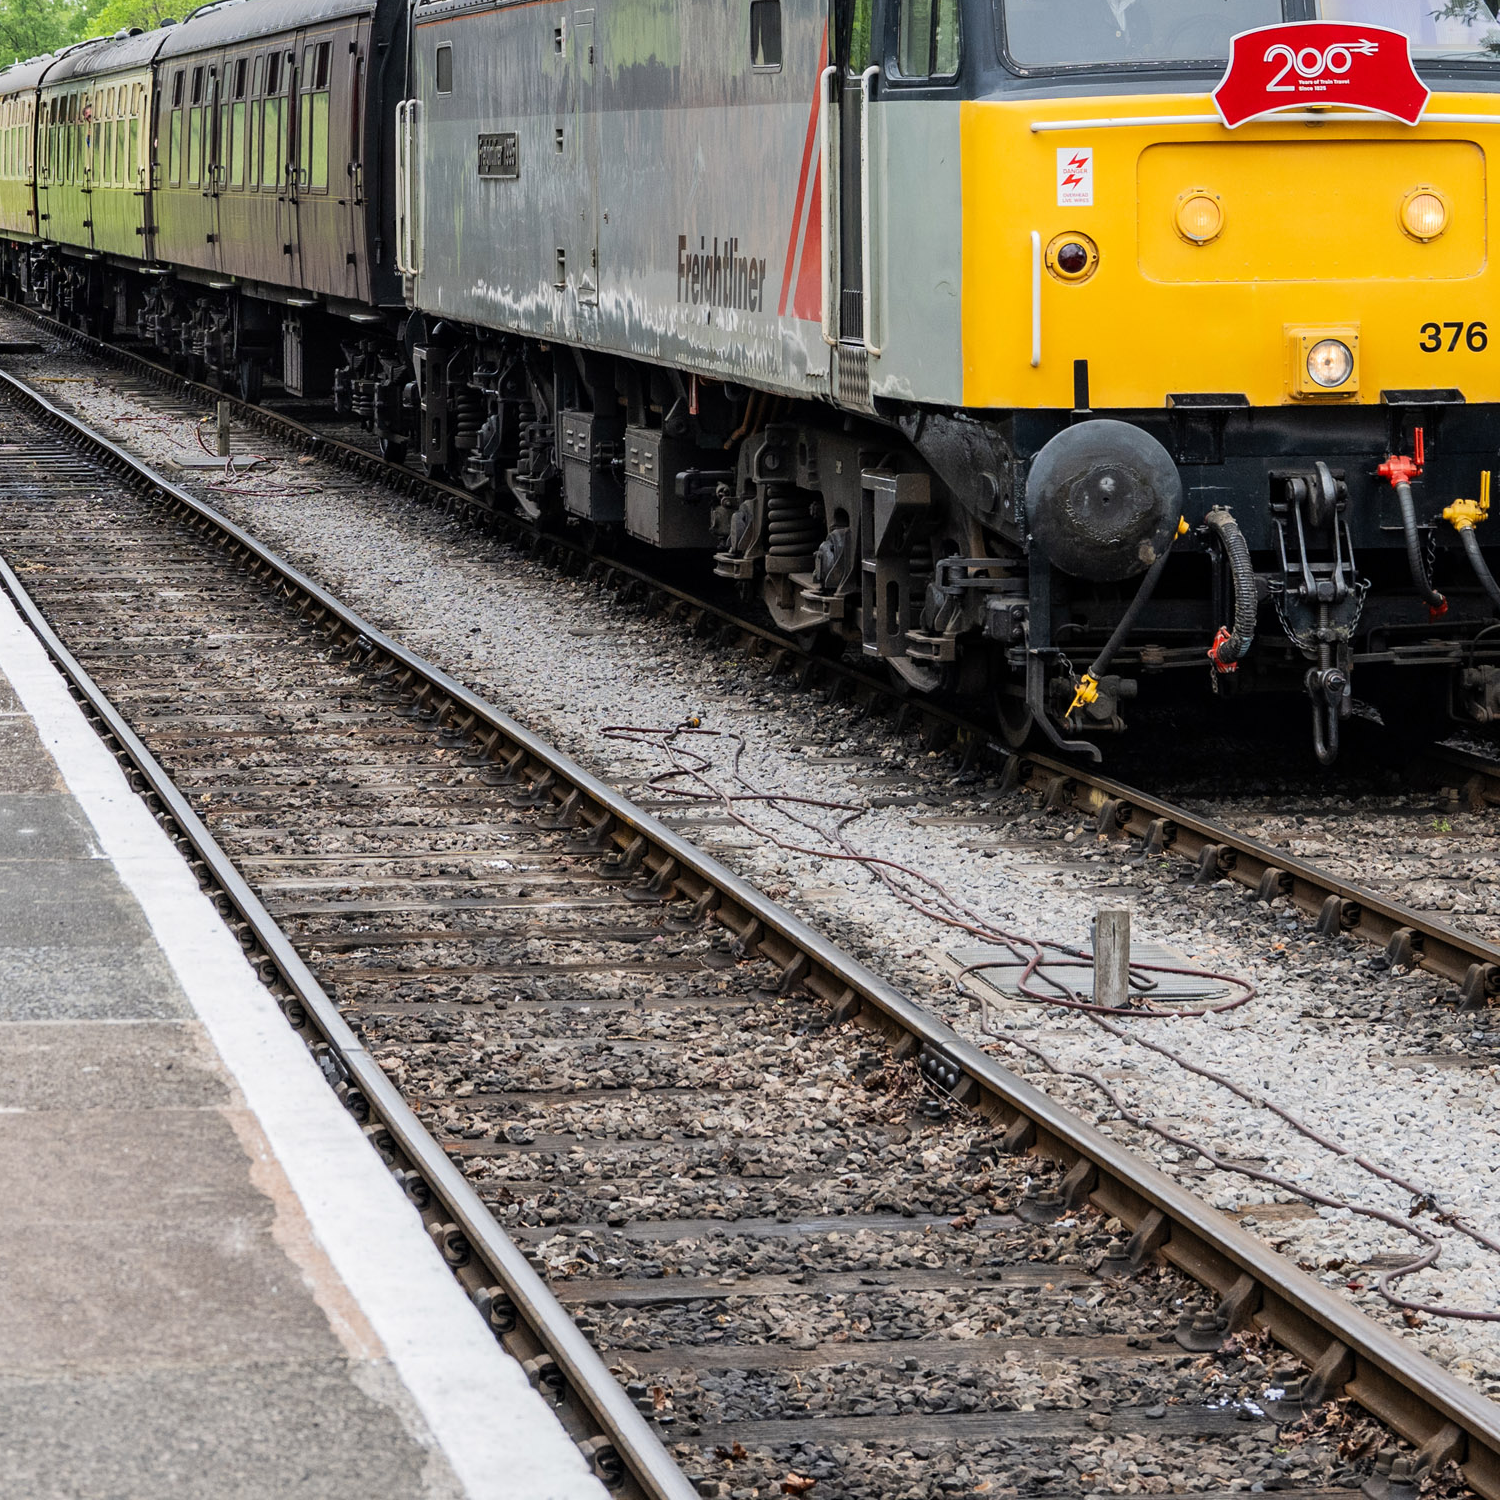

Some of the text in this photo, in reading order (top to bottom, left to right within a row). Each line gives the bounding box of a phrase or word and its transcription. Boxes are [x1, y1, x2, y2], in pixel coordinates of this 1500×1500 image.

[1263, 44, 1352, 92] 200
[677, 234, 766, 313] Freightliner
[1419, 321, 1488, 353] 376
